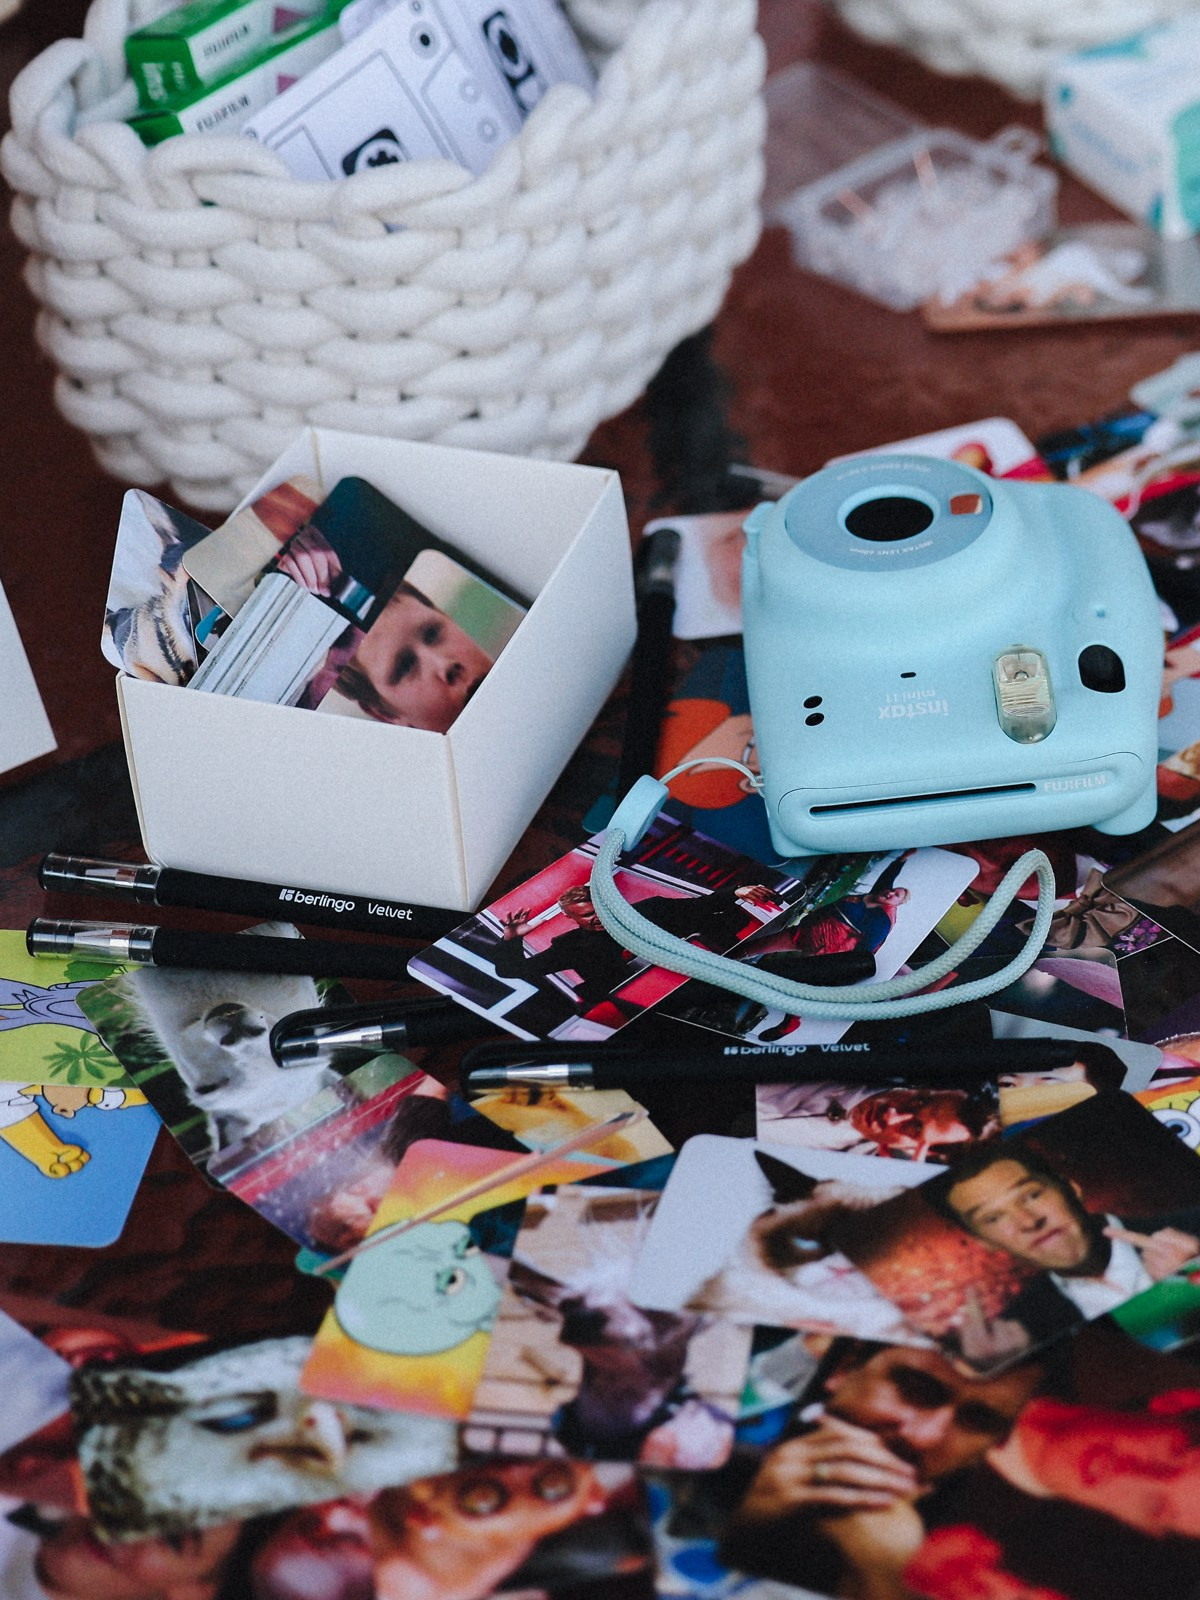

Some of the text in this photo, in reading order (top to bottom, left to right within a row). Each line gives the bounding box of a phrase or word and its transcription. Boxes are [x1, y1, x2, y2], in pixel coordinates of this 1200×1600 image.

[902, 689, 936, 702] mini
[878, 700, 949, 719] instax
[1043, 774, 1107, 792] FUJIFILM
[293, 890, 413, 921] berlingo Velvet
[819, 1043, 871, 1052] Velvet
